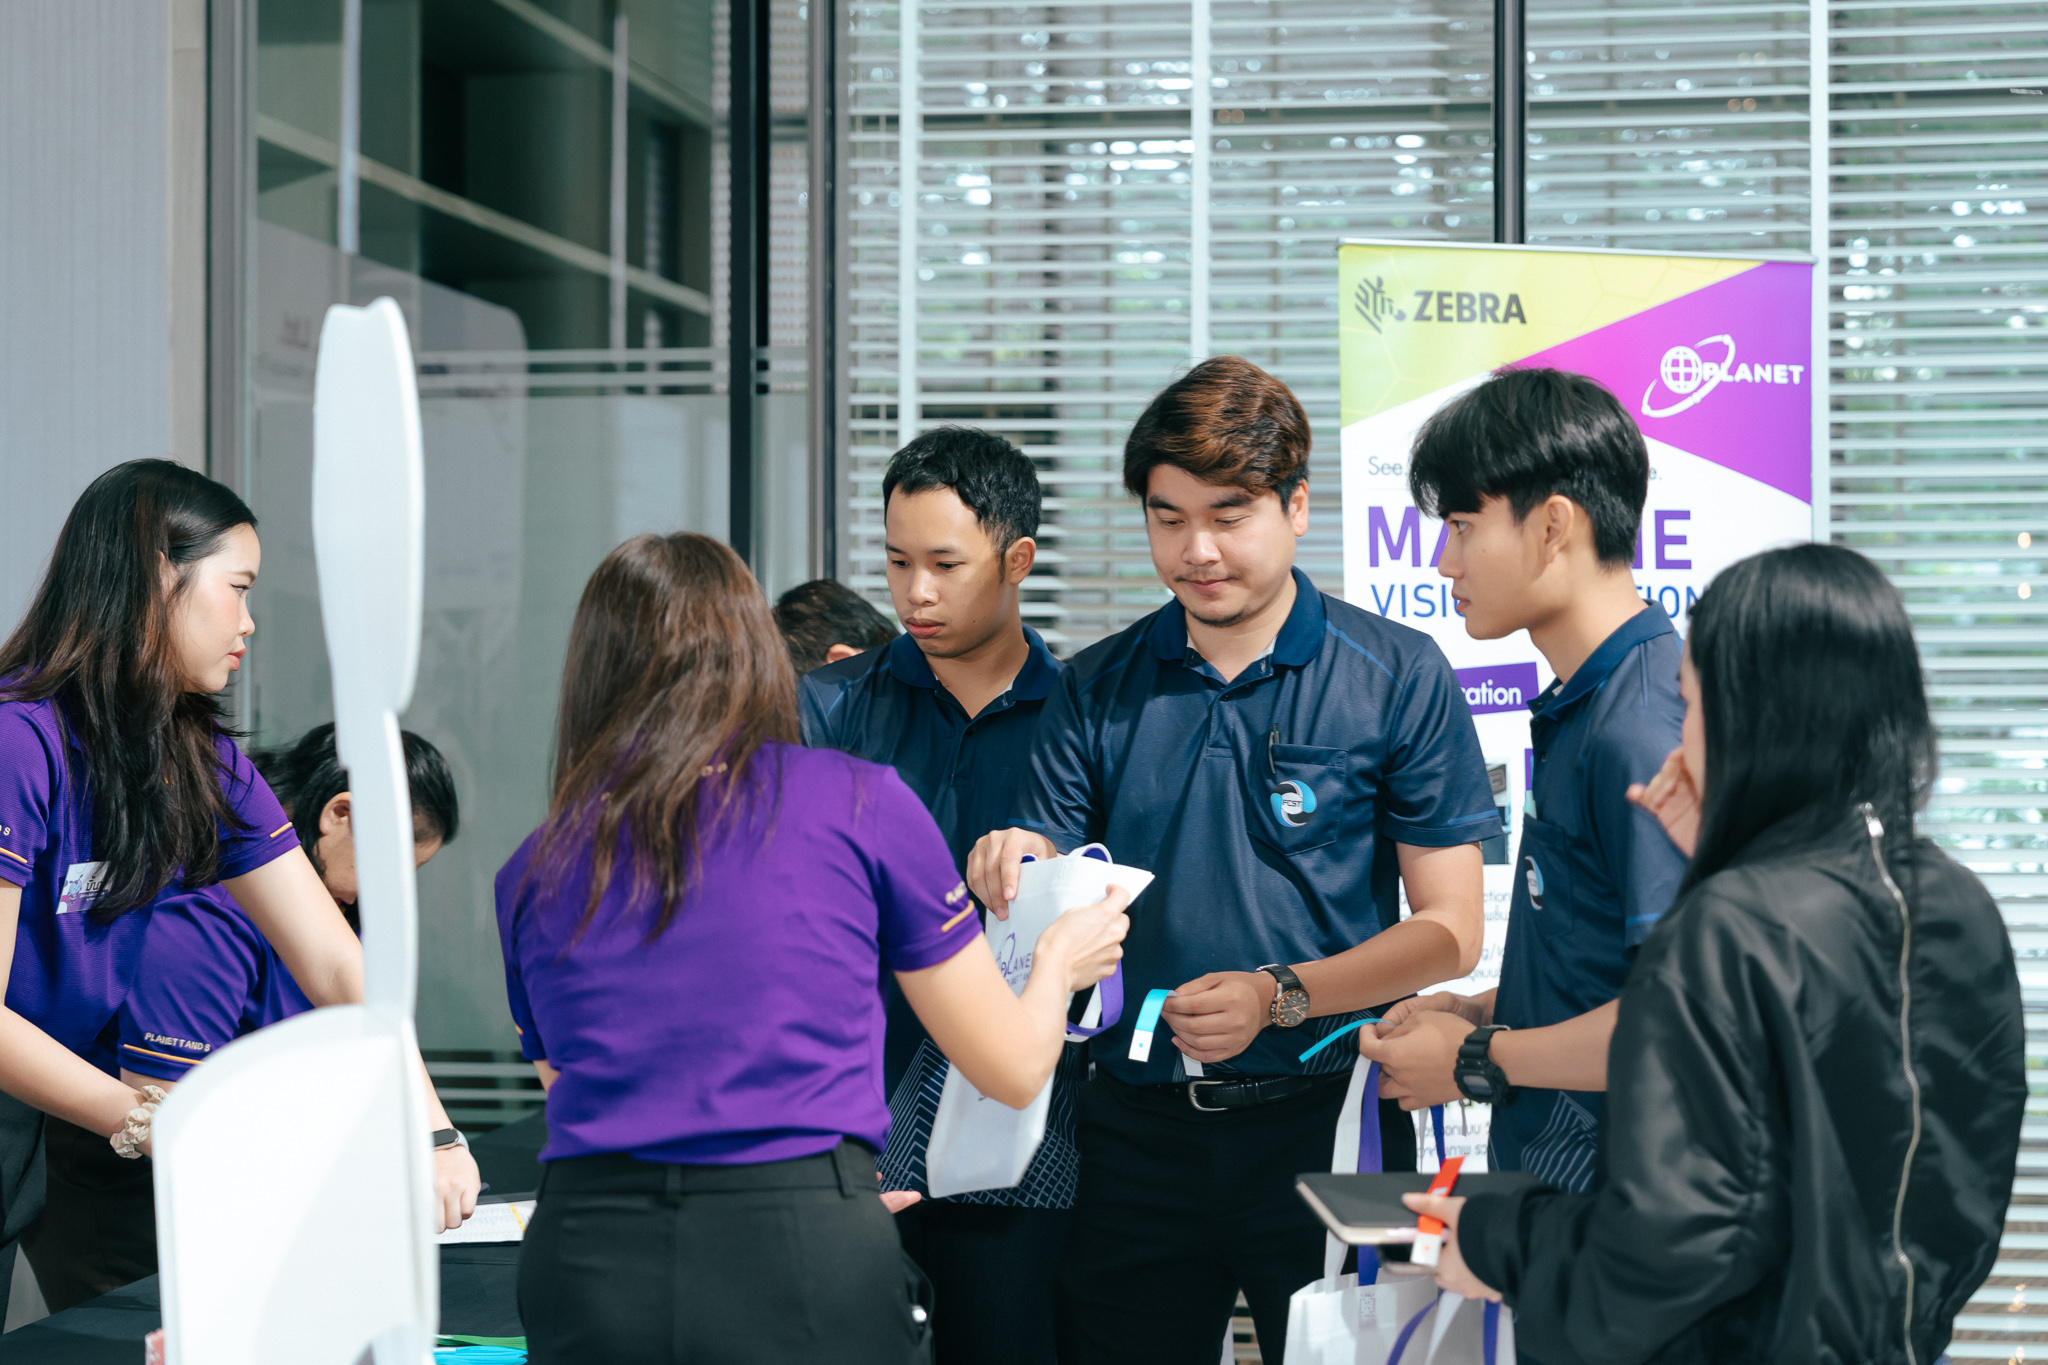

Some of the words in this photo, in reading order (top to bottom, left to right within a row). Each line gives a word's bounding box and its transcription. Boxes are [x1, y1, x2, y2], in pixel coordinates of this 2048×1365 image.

[1414, 290, 1527, 324] ZEBRA
[1702, 361, 1805, 385] PLANET
[1371, 584, 1467, 618] VISI
[1460, 678, 1522, 706] ation
[1001, 952, 1034, 975] PLANE
[144, 1031, 179, 1047] PLANET
